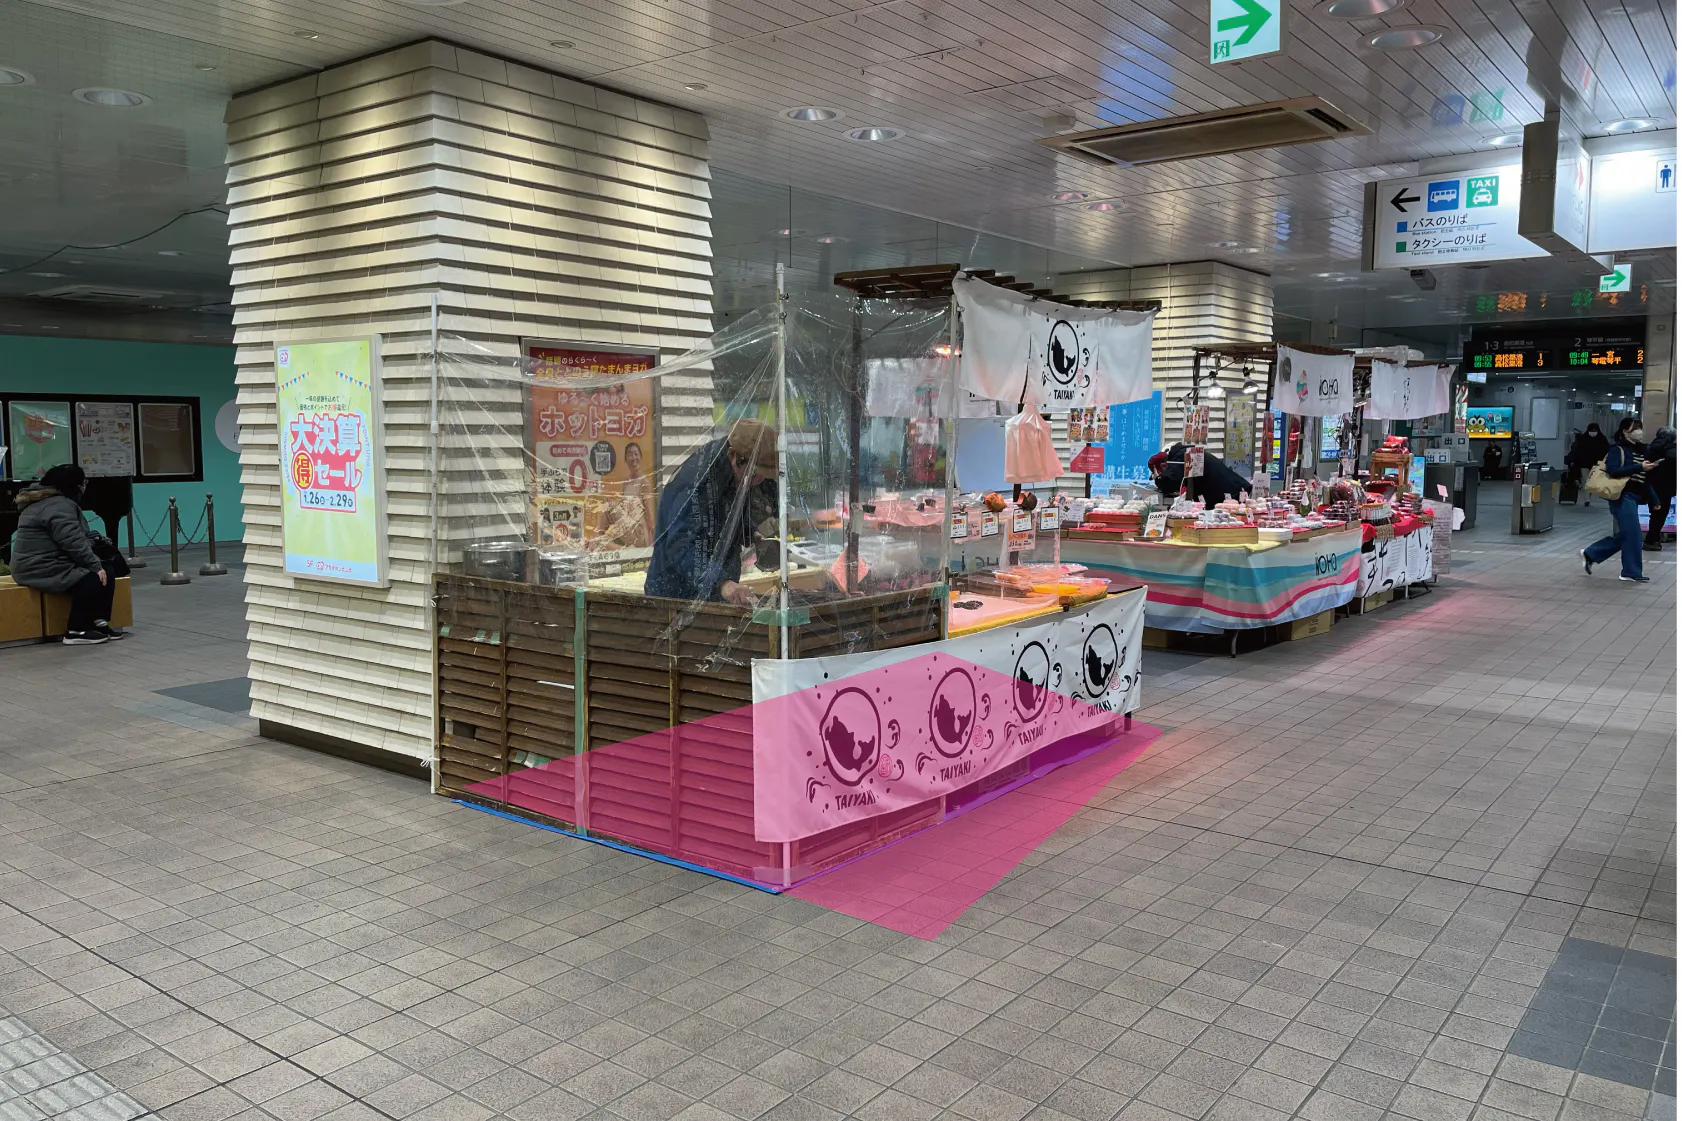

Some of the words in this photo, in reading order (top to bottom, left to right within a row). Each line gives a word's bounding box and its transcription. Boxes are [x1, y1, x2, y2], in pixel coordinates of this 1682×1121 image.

[1470, 178, 1496, 188] TAXI
[1412, 213, 1468, 229] バスのりば
[1412, 233, 1487, 250] タクシーのりば
[540, 406, 648, 439] ホットヨガ
[290, 413, 361, 456] 大決算
[1444, 437, 1466, 445] 出口
[1427, 455, 1447, 463] 出口
[315, 458, 360, 488] セール
[1091, 464, 1155, 481] 講生募
[1087, 700, 1113, 719] TAIYAKI
[1018, 725, 1045, 746] TAIYAKI
[939, 761, 971, 783] TAIYAKI
[834, 790, 876, 811] TAIYAKI
